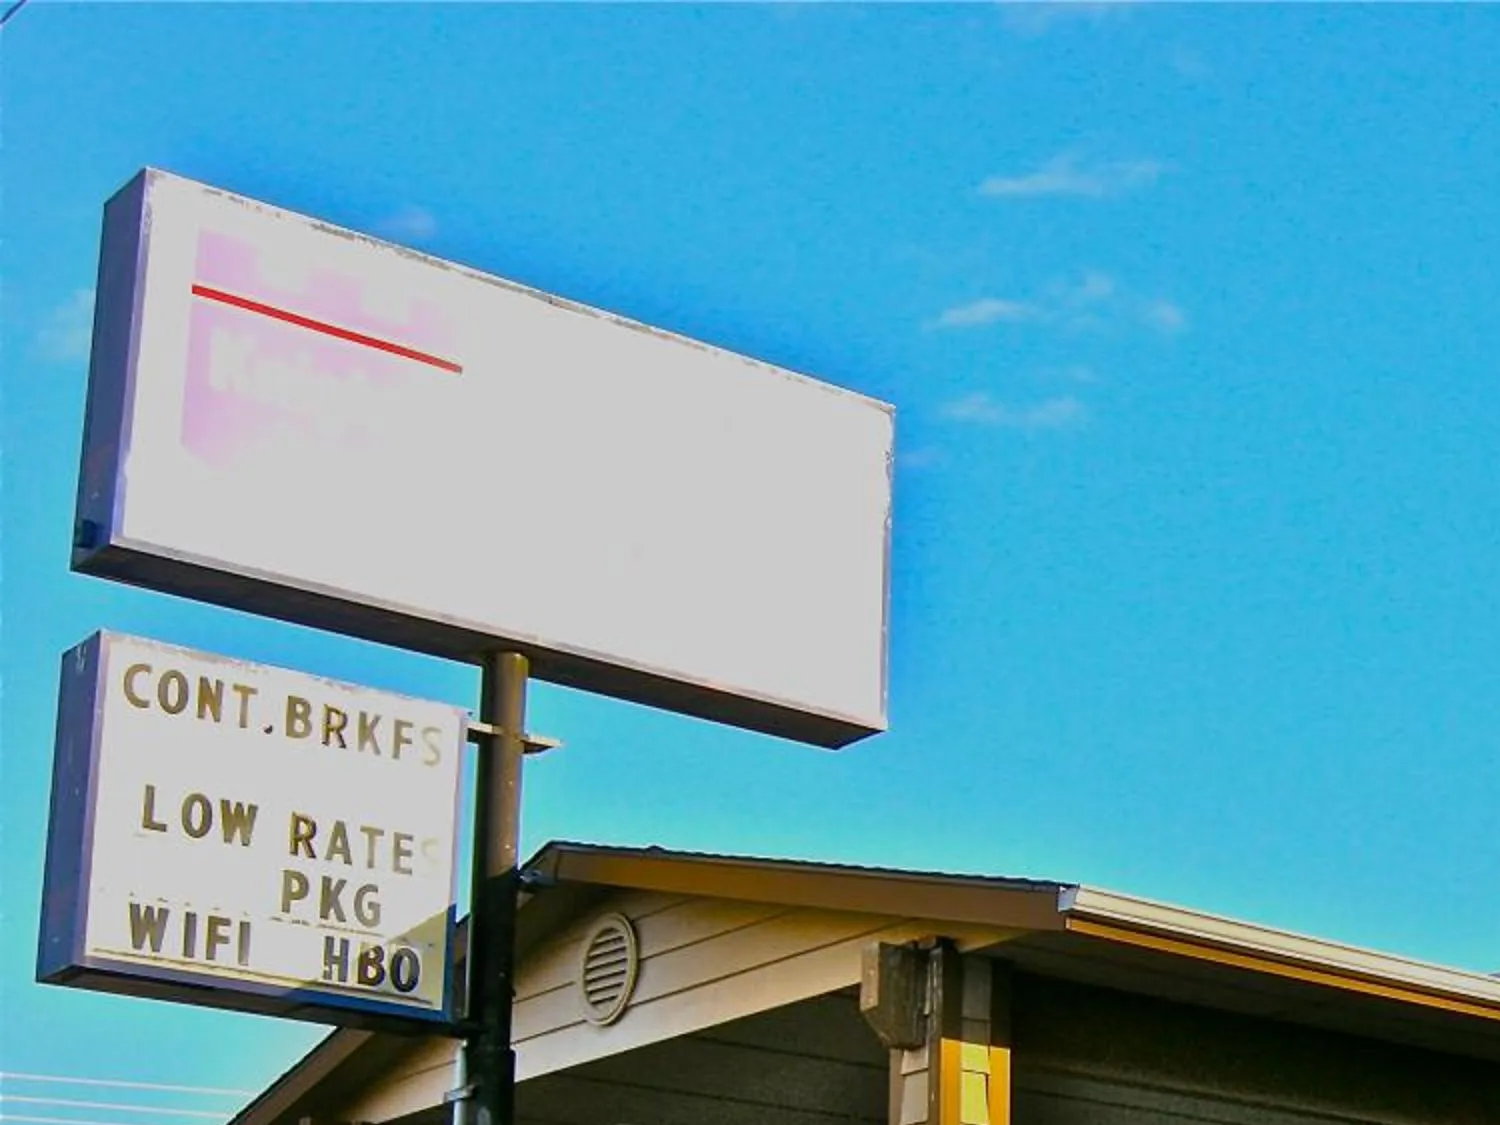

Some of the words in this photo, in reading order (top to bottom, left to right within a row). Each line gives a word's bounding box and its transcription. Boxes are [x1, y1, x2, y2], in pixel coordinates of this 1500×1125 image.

[142, 784, 258, 847] LOW
[281, 869, 381, 927] PKG
[129, 902, 252, 965] WIFI
[322, 935, 421, 992] HBO
